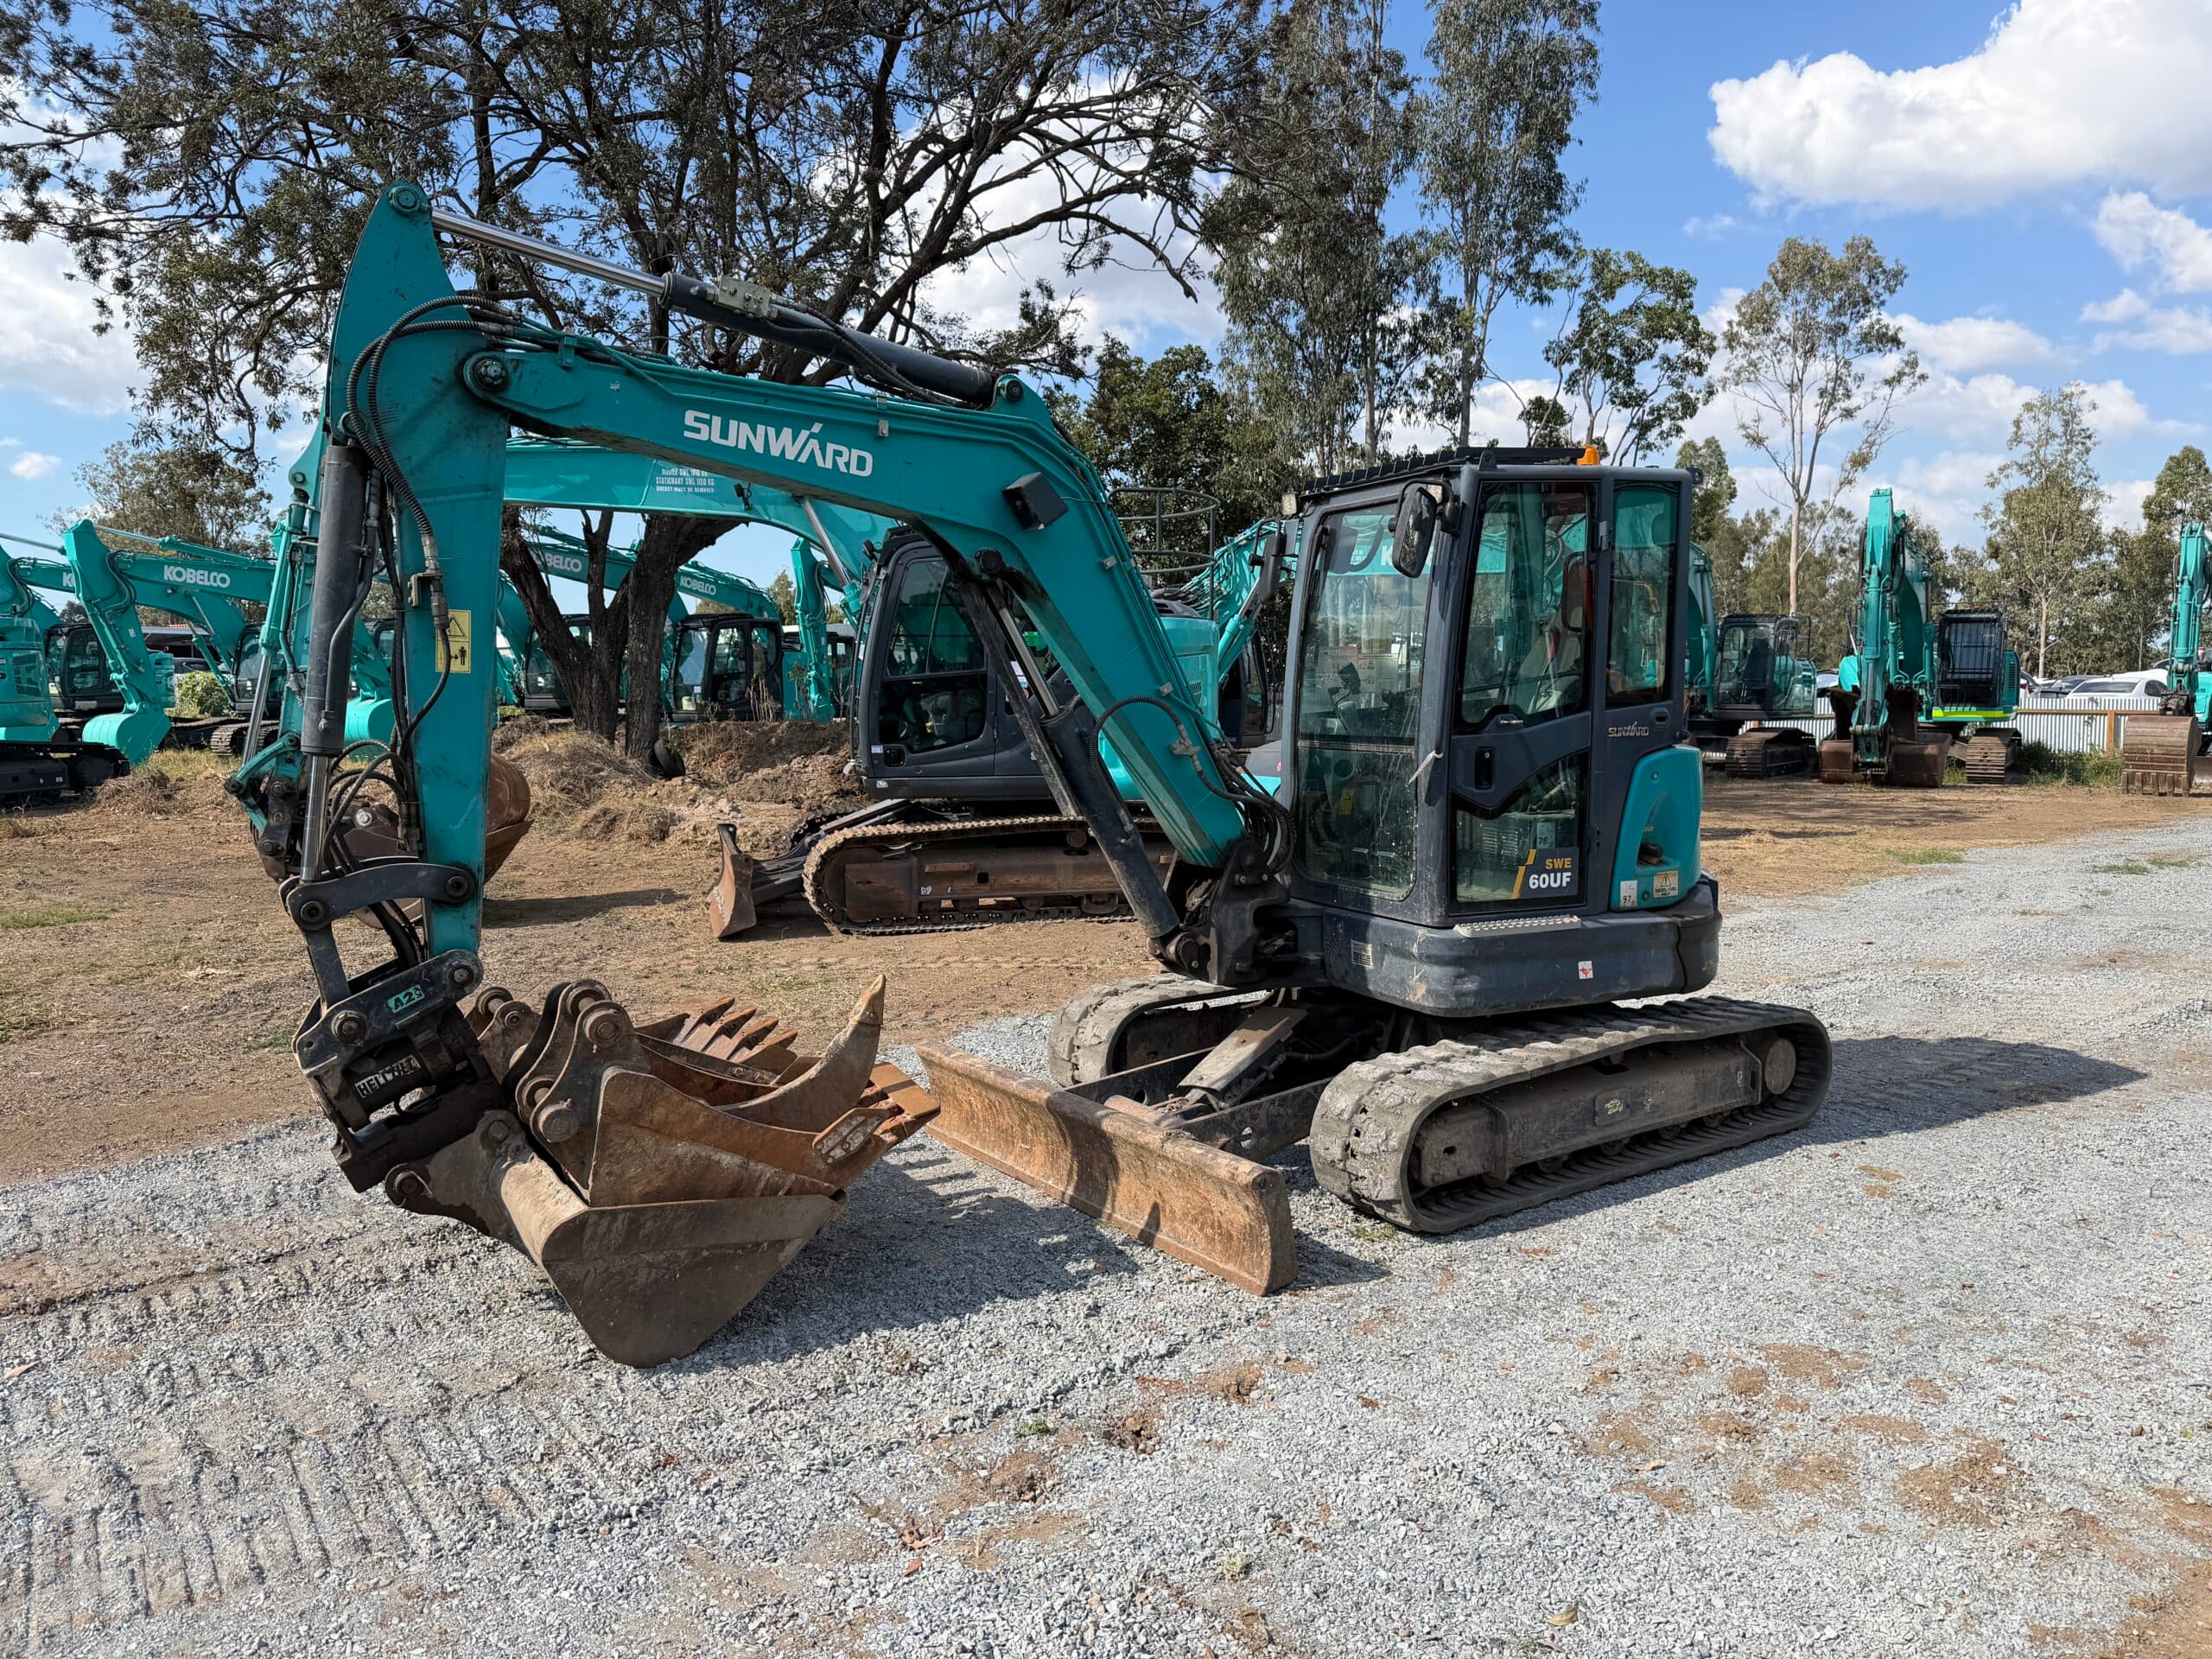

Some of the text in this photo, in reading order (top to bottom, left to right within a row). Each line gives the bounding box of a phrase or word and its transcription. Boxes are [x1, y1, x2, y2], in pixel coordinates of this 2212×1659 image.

[683, 410, 873, 477] SUNWARD
[163, 565, 231, 588] KOBELCO
[680, 576, 716, 595] KOBELCO
[1545, 857, 1572, 869] SWE
[1529, 872, 1572, 889] 60UF
